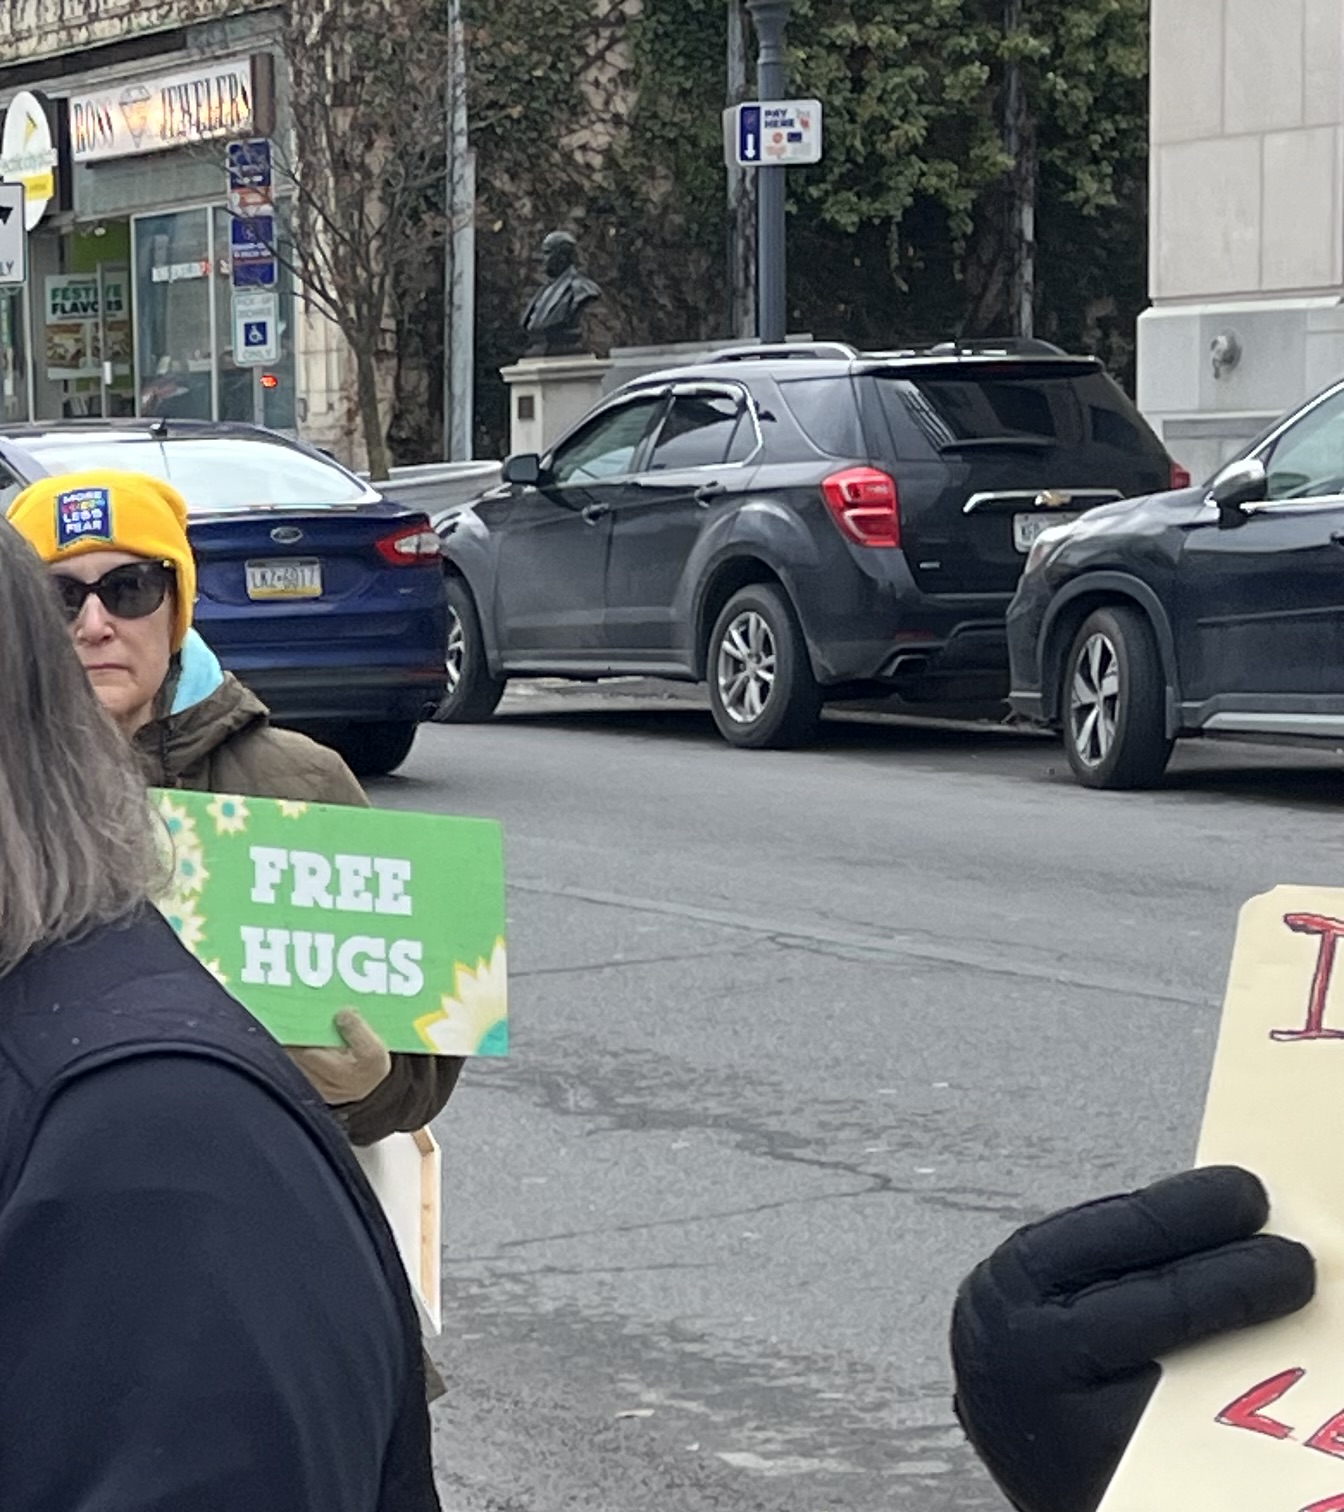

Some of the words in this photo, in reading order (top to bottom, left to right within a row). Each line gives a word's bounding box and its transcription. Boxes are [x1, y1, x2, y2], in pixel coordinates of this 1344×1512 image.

[74, 100, 114, 153] ROSS
[161, 70, 252, 139] JEWELERS
[764, 109, 787, 117] PAY
[765, 119, 794, 128] HERE
[63, 491, 102, 504] MORE
[63, 508, 103, 523] LESS
[66, 520, 102, 534] FEAR
[249, 845, 413, 916] FREE
[240, 925, 425, 998] HUGS
